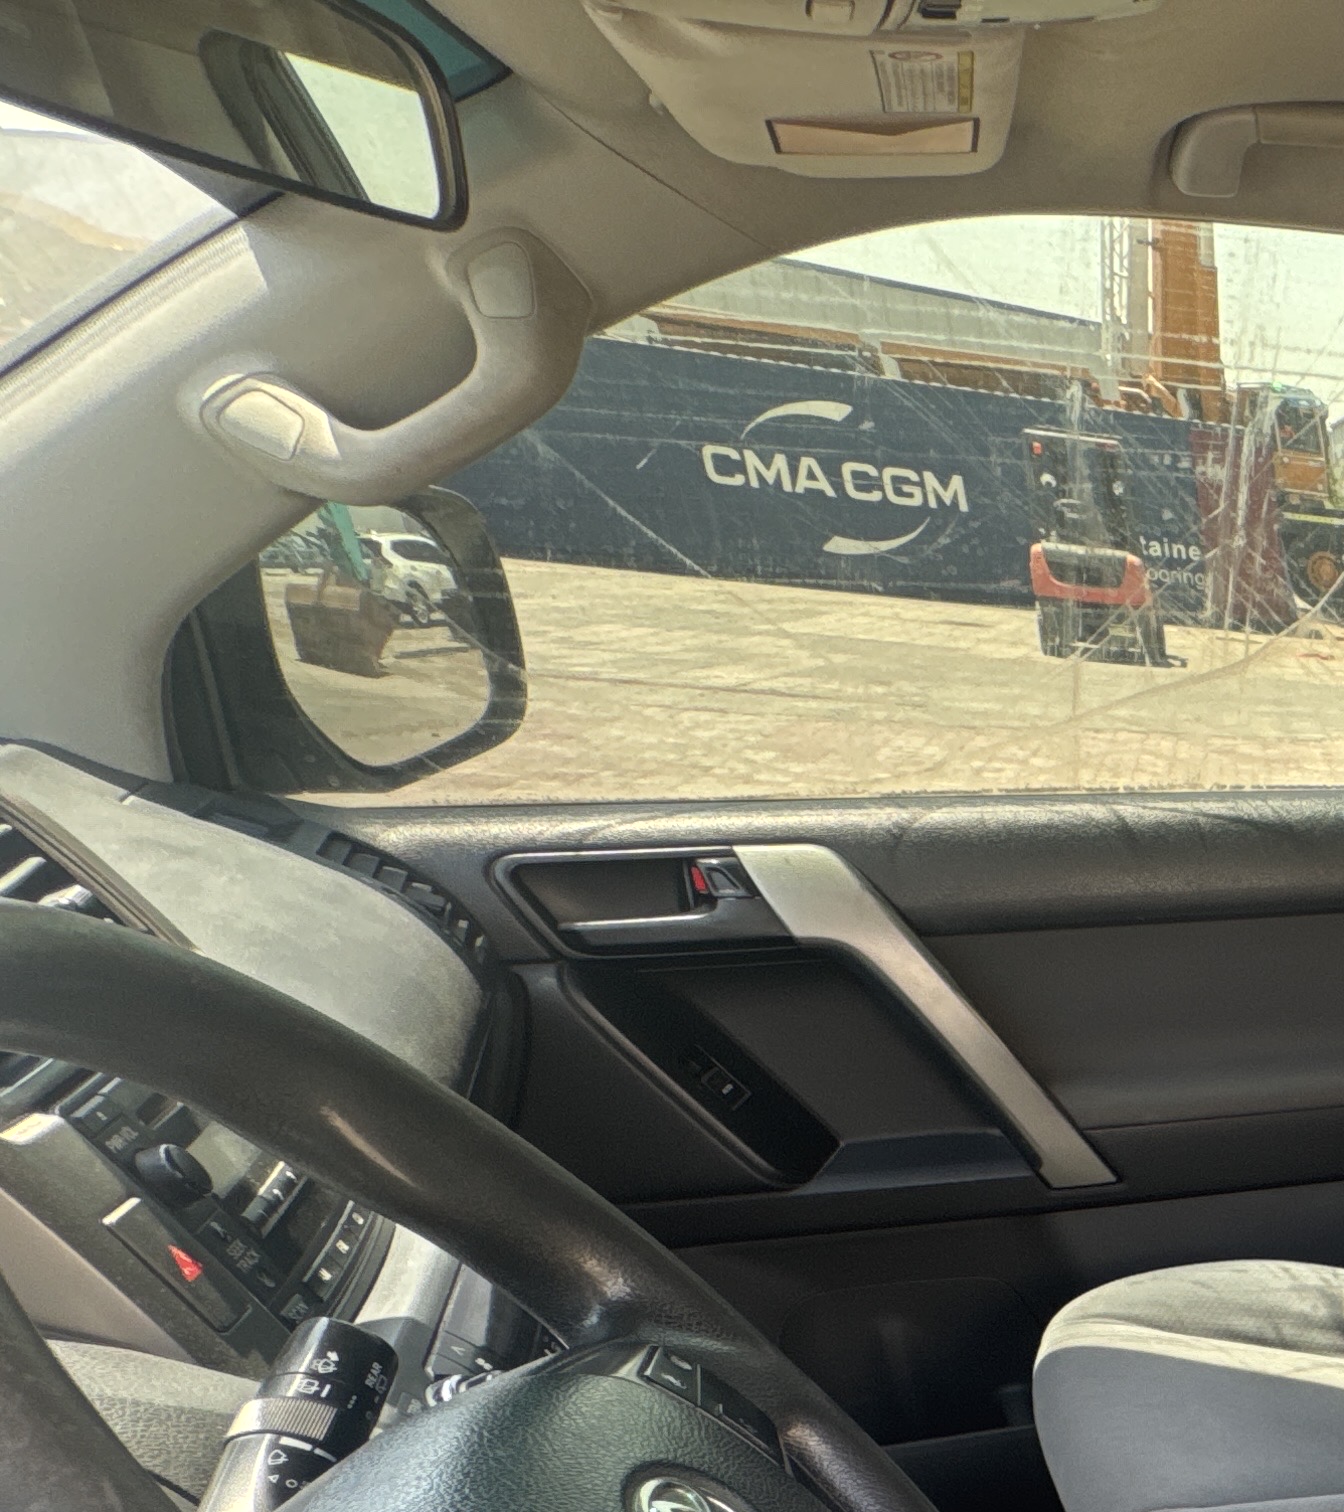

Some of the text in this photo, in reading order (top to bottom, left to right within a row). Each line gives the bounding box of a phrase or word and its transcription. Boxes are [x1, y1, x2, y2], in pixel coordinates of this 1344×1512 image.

[701, 444, 970, 513] CMA CGM
[1138, 535, 1203, 561] taine
[365, 1361, 383, 1390] REAR
